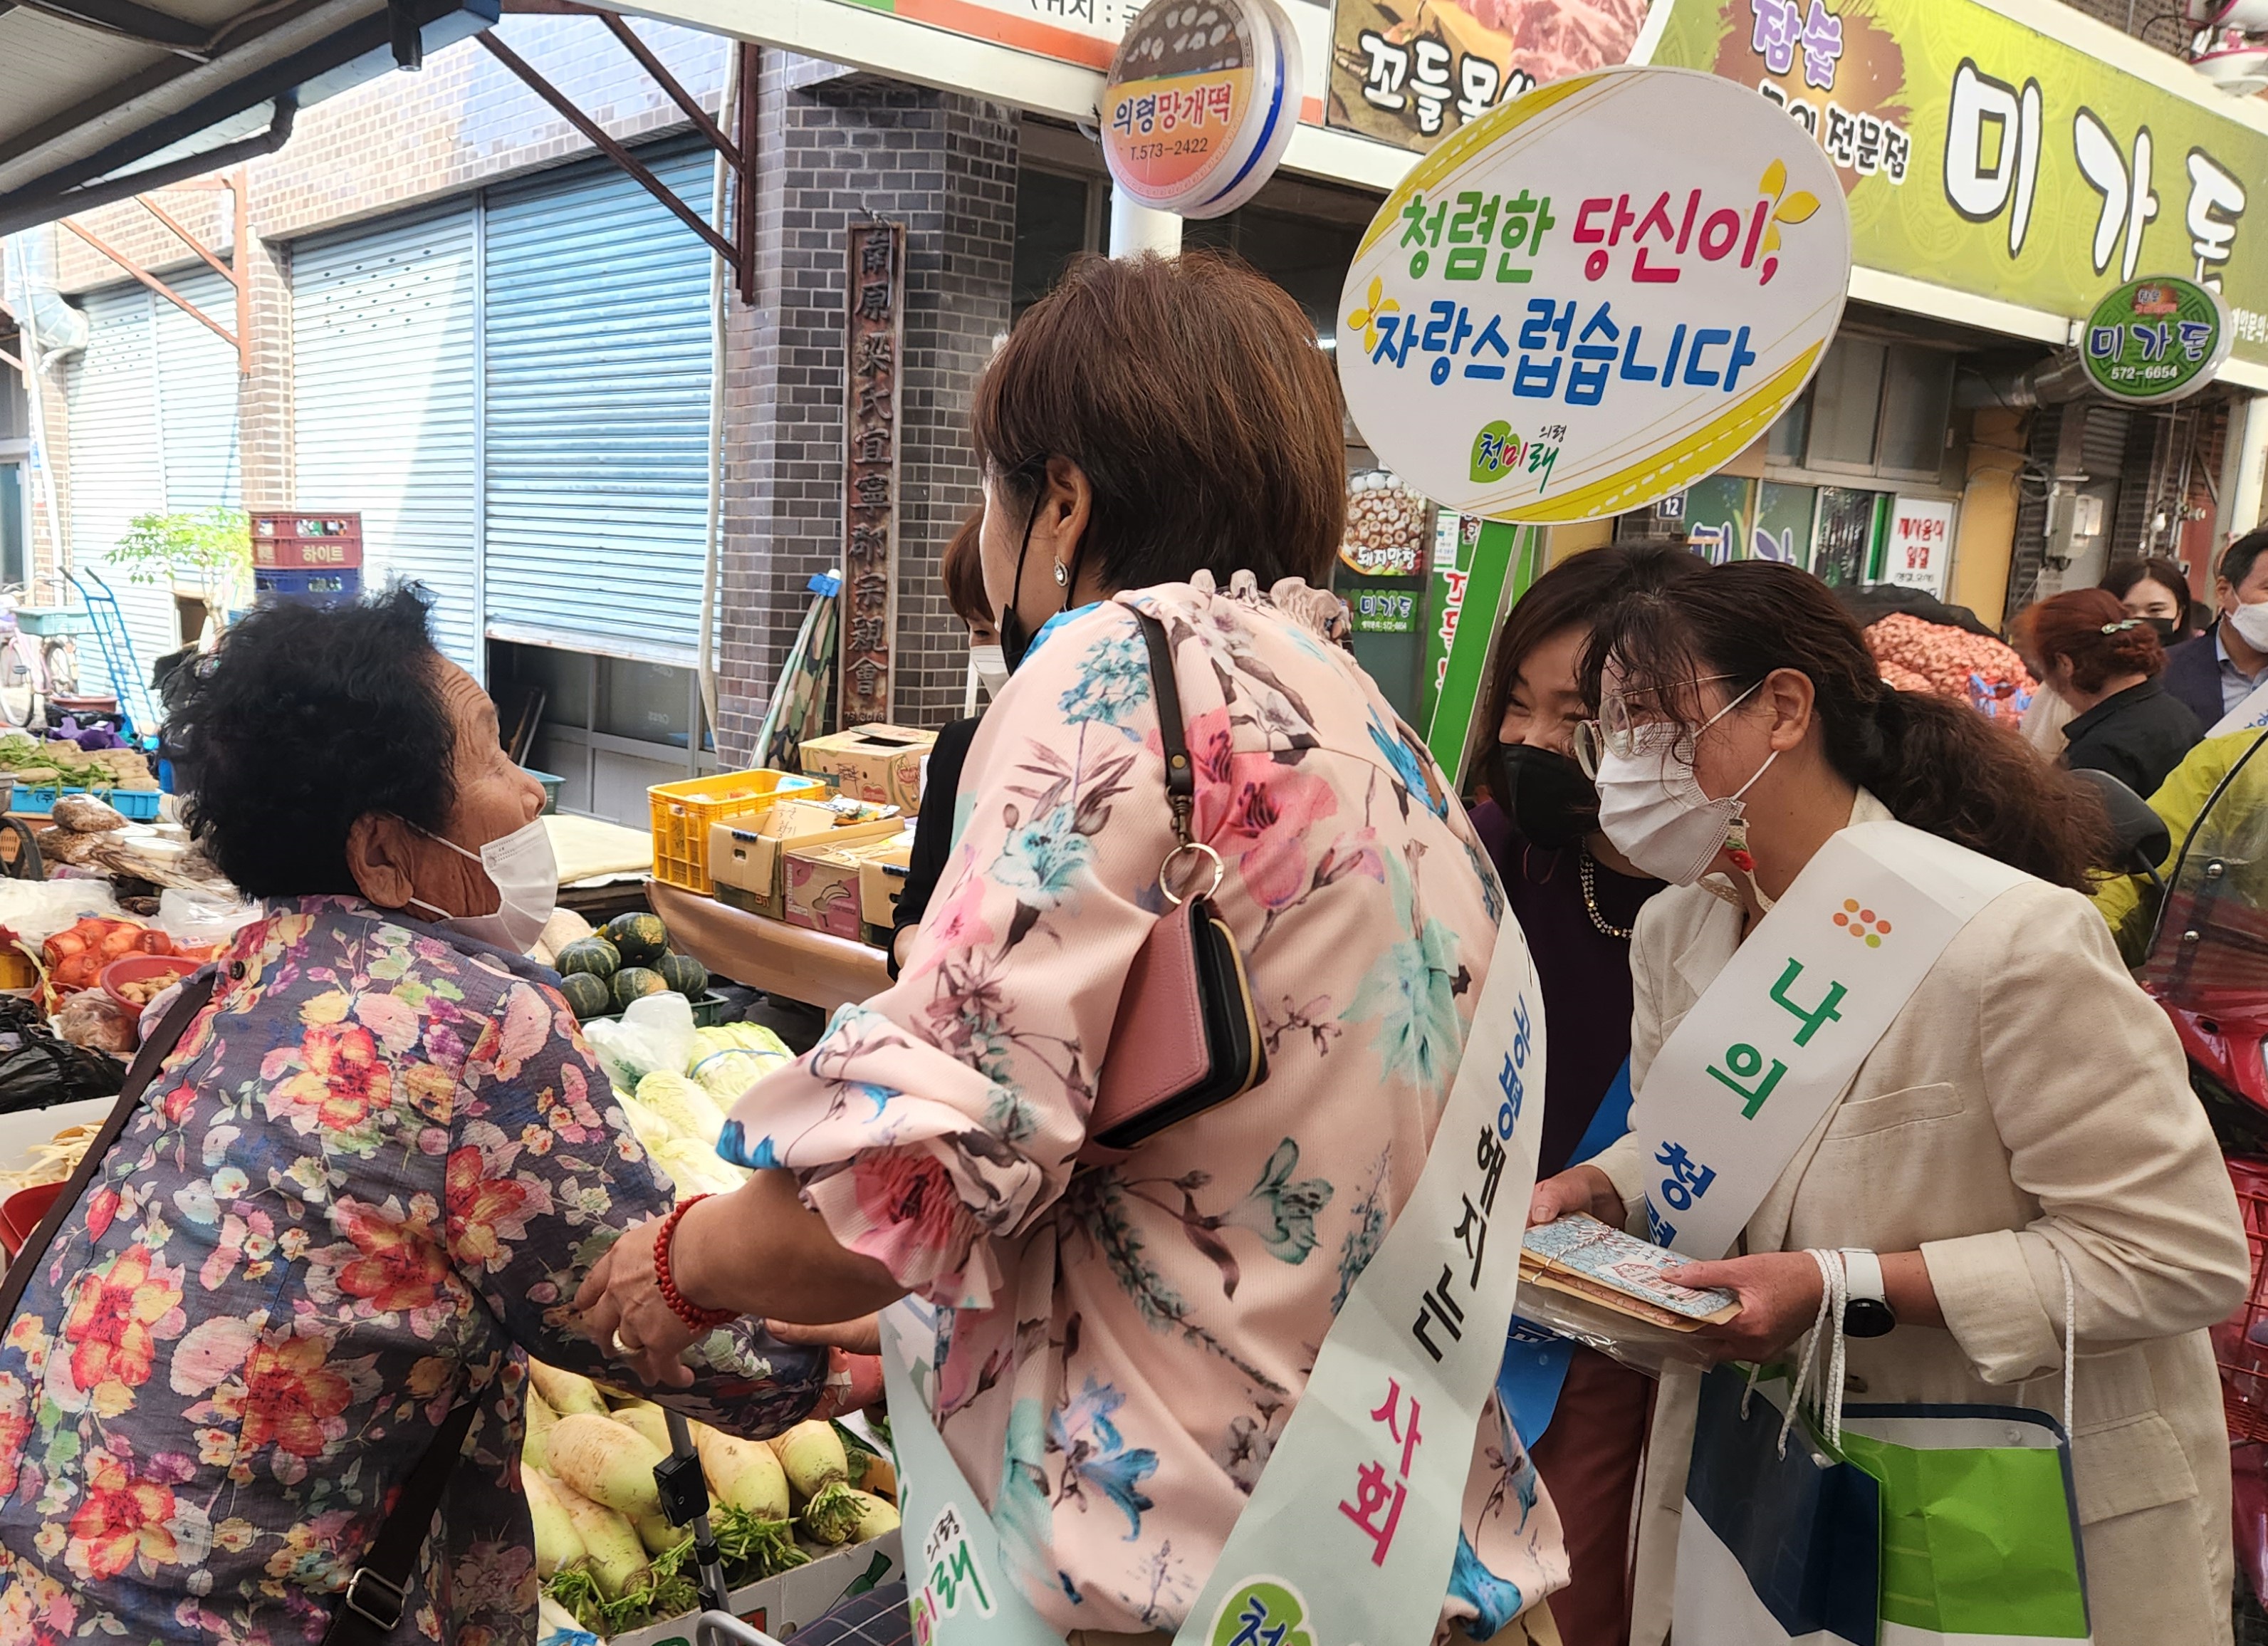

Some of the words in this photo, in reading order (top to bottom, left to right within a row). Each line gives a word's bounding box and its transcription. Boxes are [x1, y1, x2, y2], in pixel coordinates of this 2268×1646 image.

[1112, 83, 1233, 136] 의령망개떡
[1129, 137, 1208, 162] T.573-2422
[1401, 189, 1555, 283] 청렴한
[1573, 189, 1778, 286] 당신이,
[1373, 298, 1756, 407] 자랑스럽습니다
[2090, 321, 2212, 363] 미가돈
[2111, 365, 2178, 380] 572-6654
[1539, 424, 1567, 442] 의령
[1478, 433, 1559, 494] 청미래
[1665, 498, 1679, 516] 12
[302, 545, 345, 563] 하이트
[1357, 546, 1416, 570] 돼지막창
[1705, 956, 1849, 1120] 나의
[1412, 990, 1532, 1363] 공평해지는
[1338, 1376, 1423, 1568] 사회
